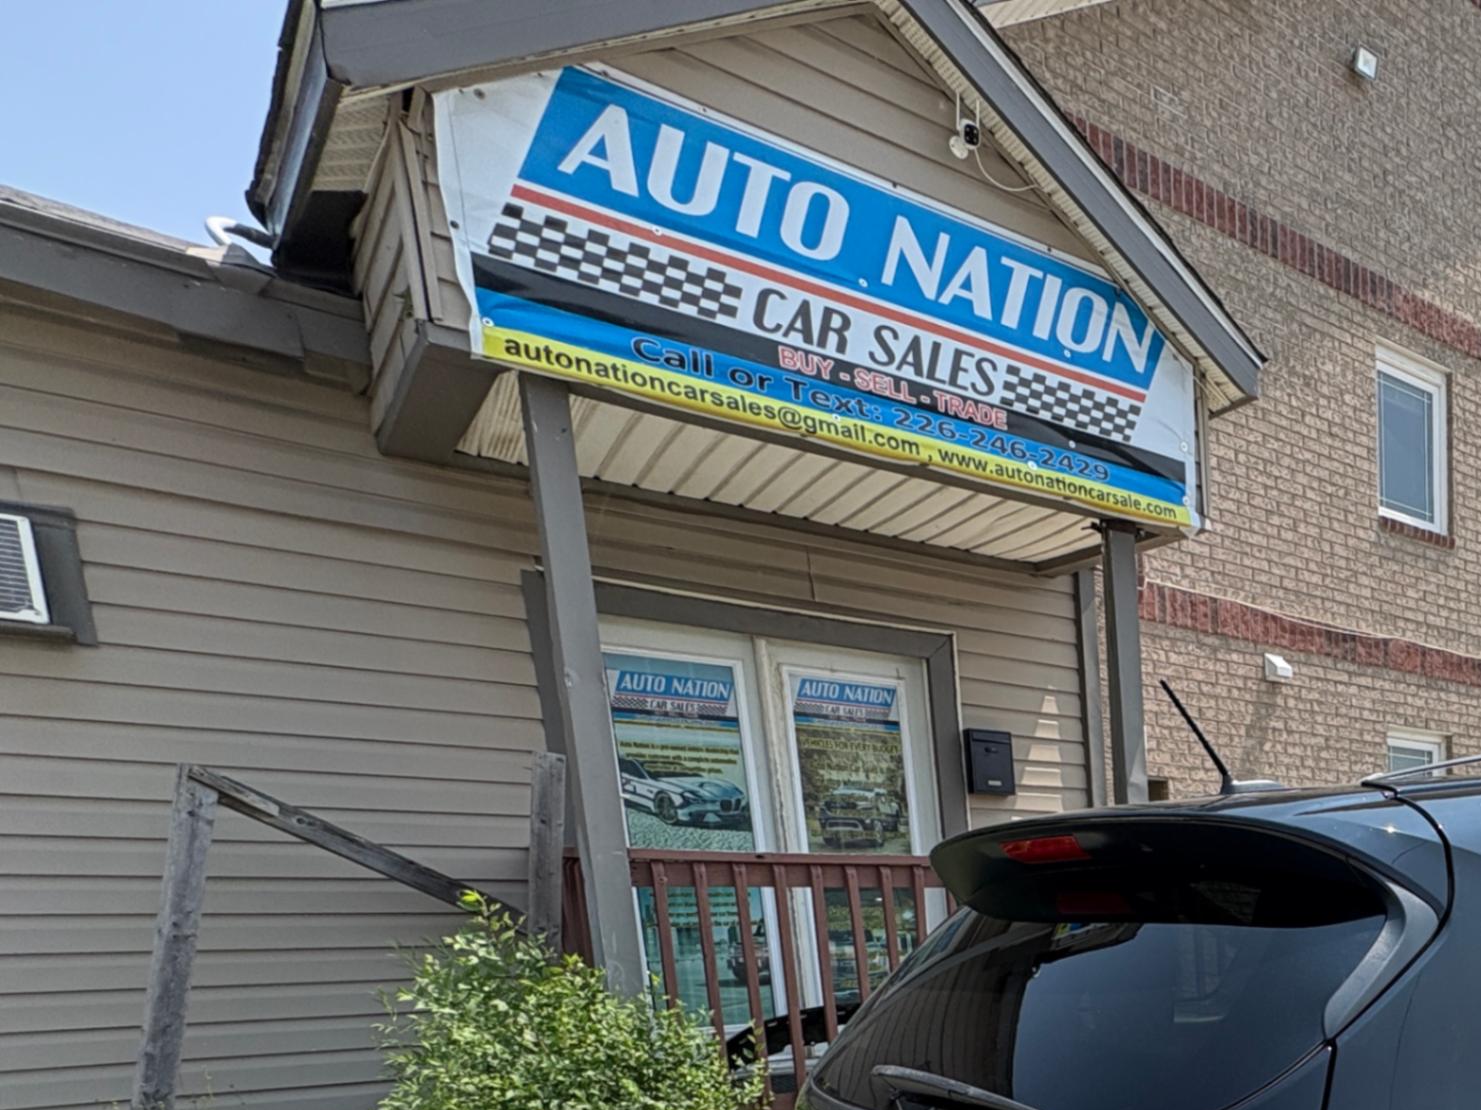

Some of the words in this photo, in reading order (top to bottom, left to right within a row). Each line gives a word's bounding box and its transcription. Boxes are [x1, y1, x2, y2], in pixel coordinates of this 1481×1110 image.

[557, 103, 850, 261] AUTO
[881, 214, 1155, 374] NATION
[753, 287, 850, 356] CAR
[868, 324, 998, 397] SALES
[777, 345, 835, 380] BUY
[854, 367, 917, 406] SELL
[933, 390, 1008, 431] TRADE
[504, 338, 921, 457] autonationcarsales@gmail.com
[937, 448, 1177, 520] www.autonationcarsale.com
[631, 336, 715, 379] Call
[728, 366, 773, 392] or
[784, 376, 883, 422] Text:
[893, 407, 1110, 482] 226-246-2429
[619, 673, 667, 693] AUTO
[671, 678, 730, 699] NATION
[800, 680, 840, 699] AUTO
[844, 685, 893, 705] NATION
